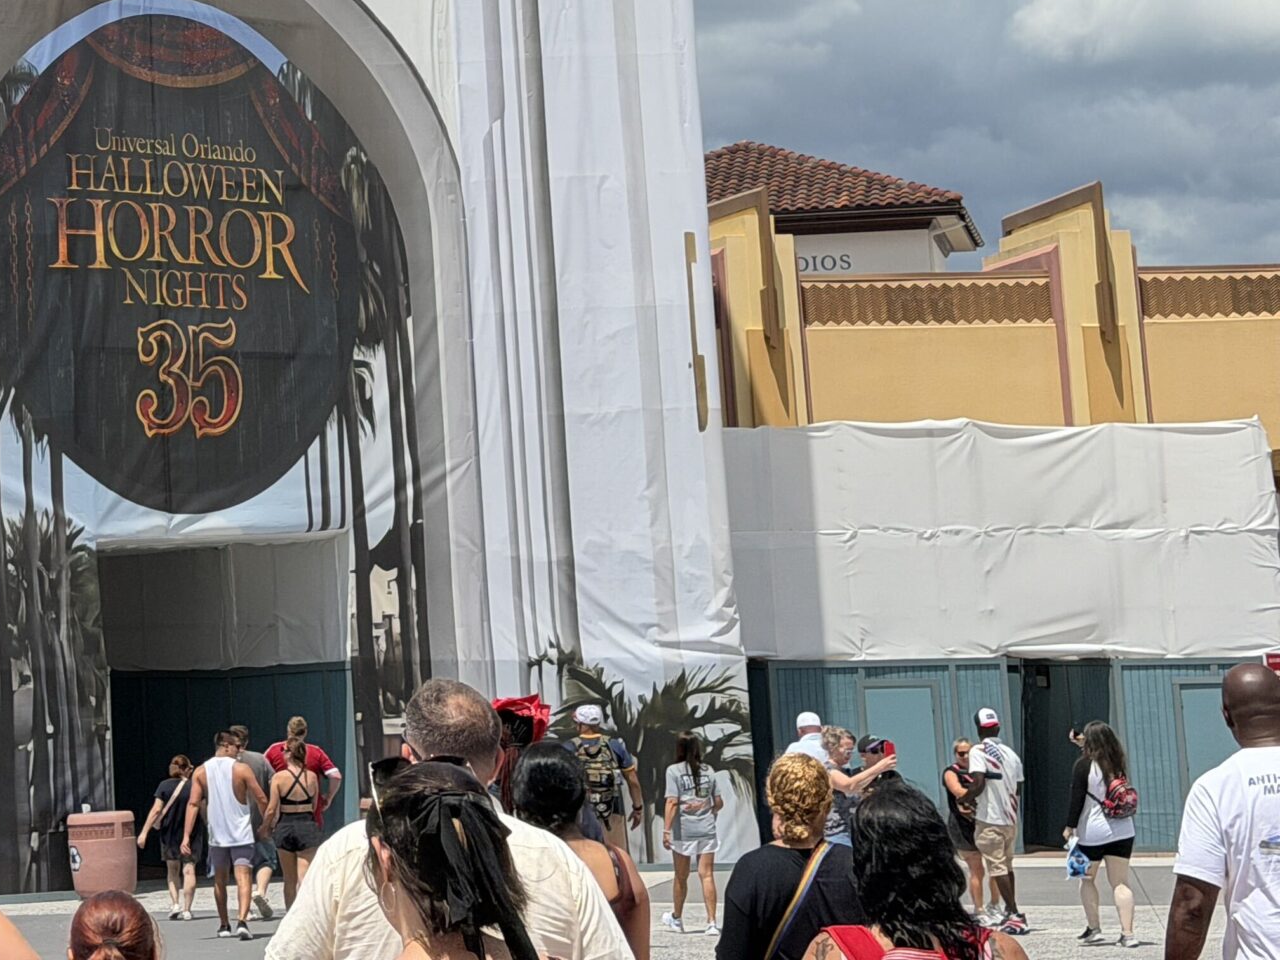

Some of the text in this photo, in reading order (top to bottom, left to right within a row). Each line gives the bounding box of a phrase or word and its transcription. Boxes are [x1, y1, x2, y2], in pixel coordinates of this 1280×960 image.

[93, 127, 256, 162] Universal Orlando
[66, 153, 285, 206] HALLOWEEN
[47, 197, 310, 295] HORROR
[123, 268, 248, 310] NIGHTS
[136, 317, 243, 438] 35
